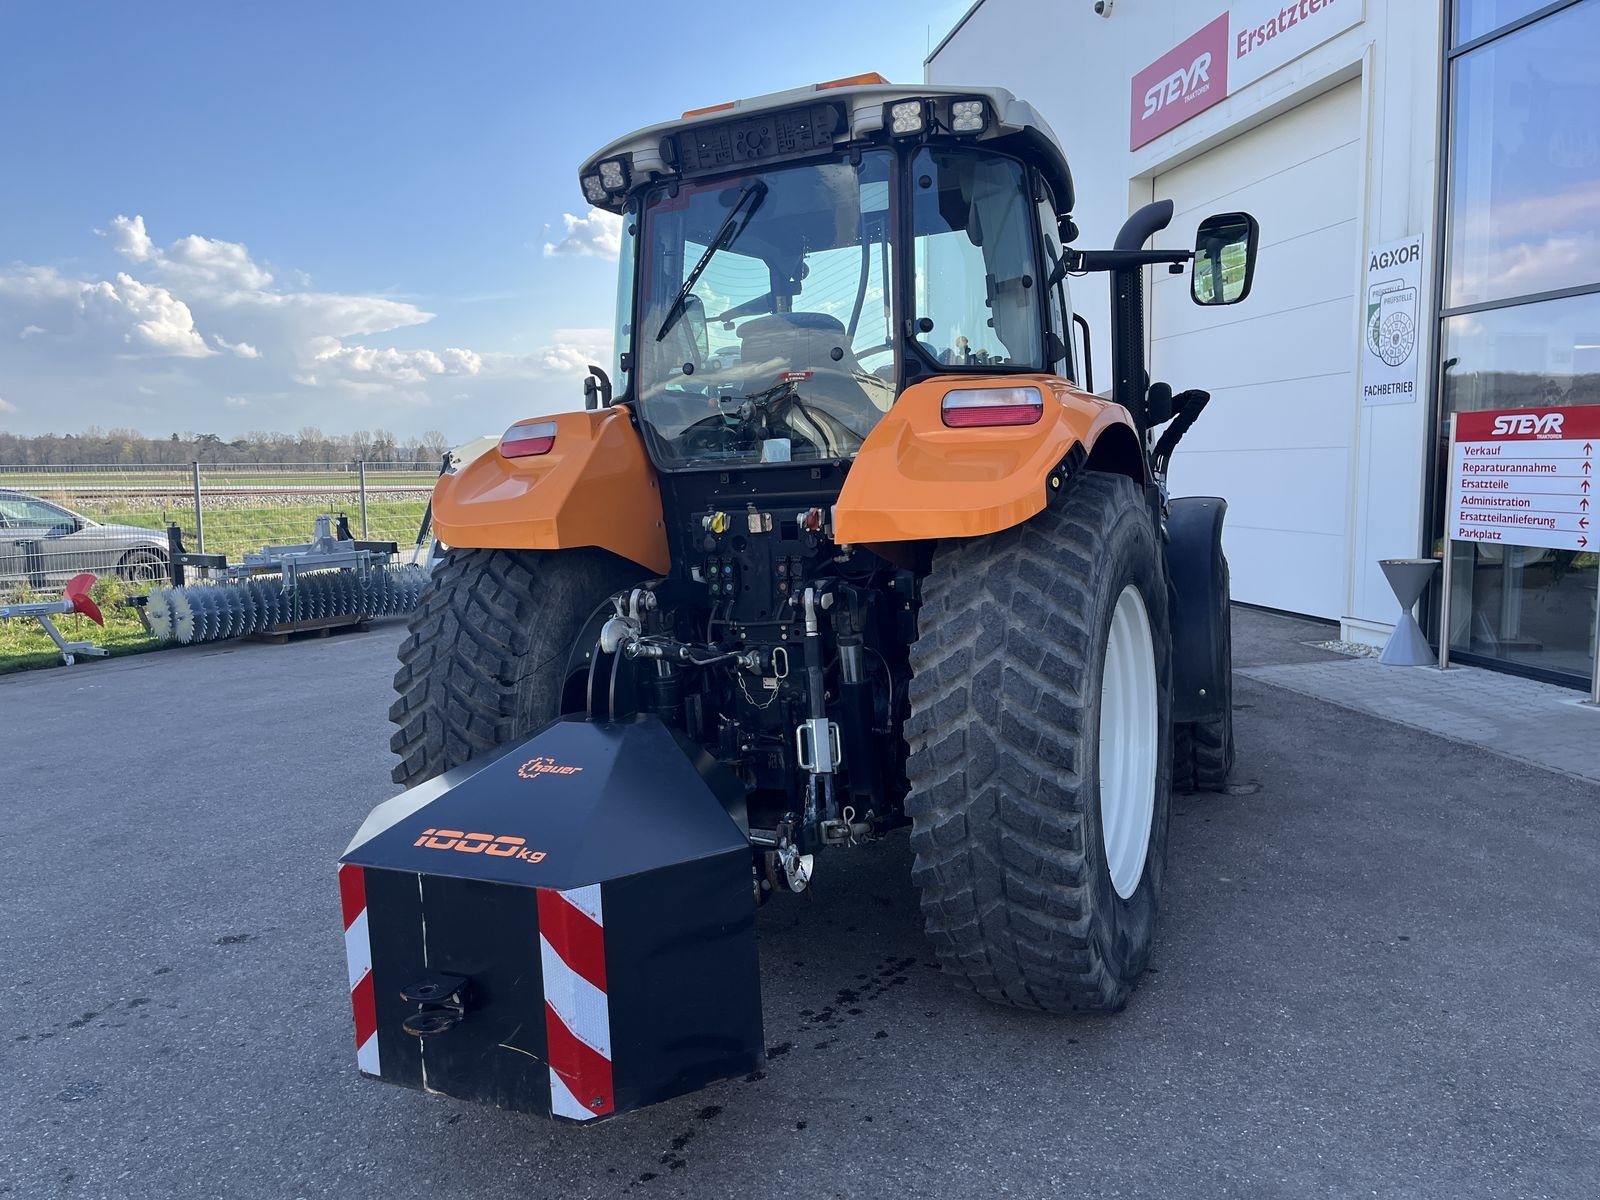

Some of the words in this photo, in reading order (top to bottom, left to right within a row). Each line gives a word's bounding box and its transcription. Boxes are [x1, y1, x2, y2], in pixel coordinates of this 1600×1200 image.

[1141, 52, 1211, 120] STEYR
[1369, 244, 1419, 272] AGXOR
[1364, 381, 1413, 397] FACHBETRIEB
[1491, 413, 1564, 435] STEYR
[1464, 446, 1501, 456] Verkauf
[1462, 463, 1557, 474] Reparaturannahme
[1461, 479, 1509, 490] Ersatzteile
[1461, 496, 1530, 507] Administration
[1460, 512, 1556, 528] Ersatzteilanlieferung
[1459, 528, 1502, 540] Parkplatz
